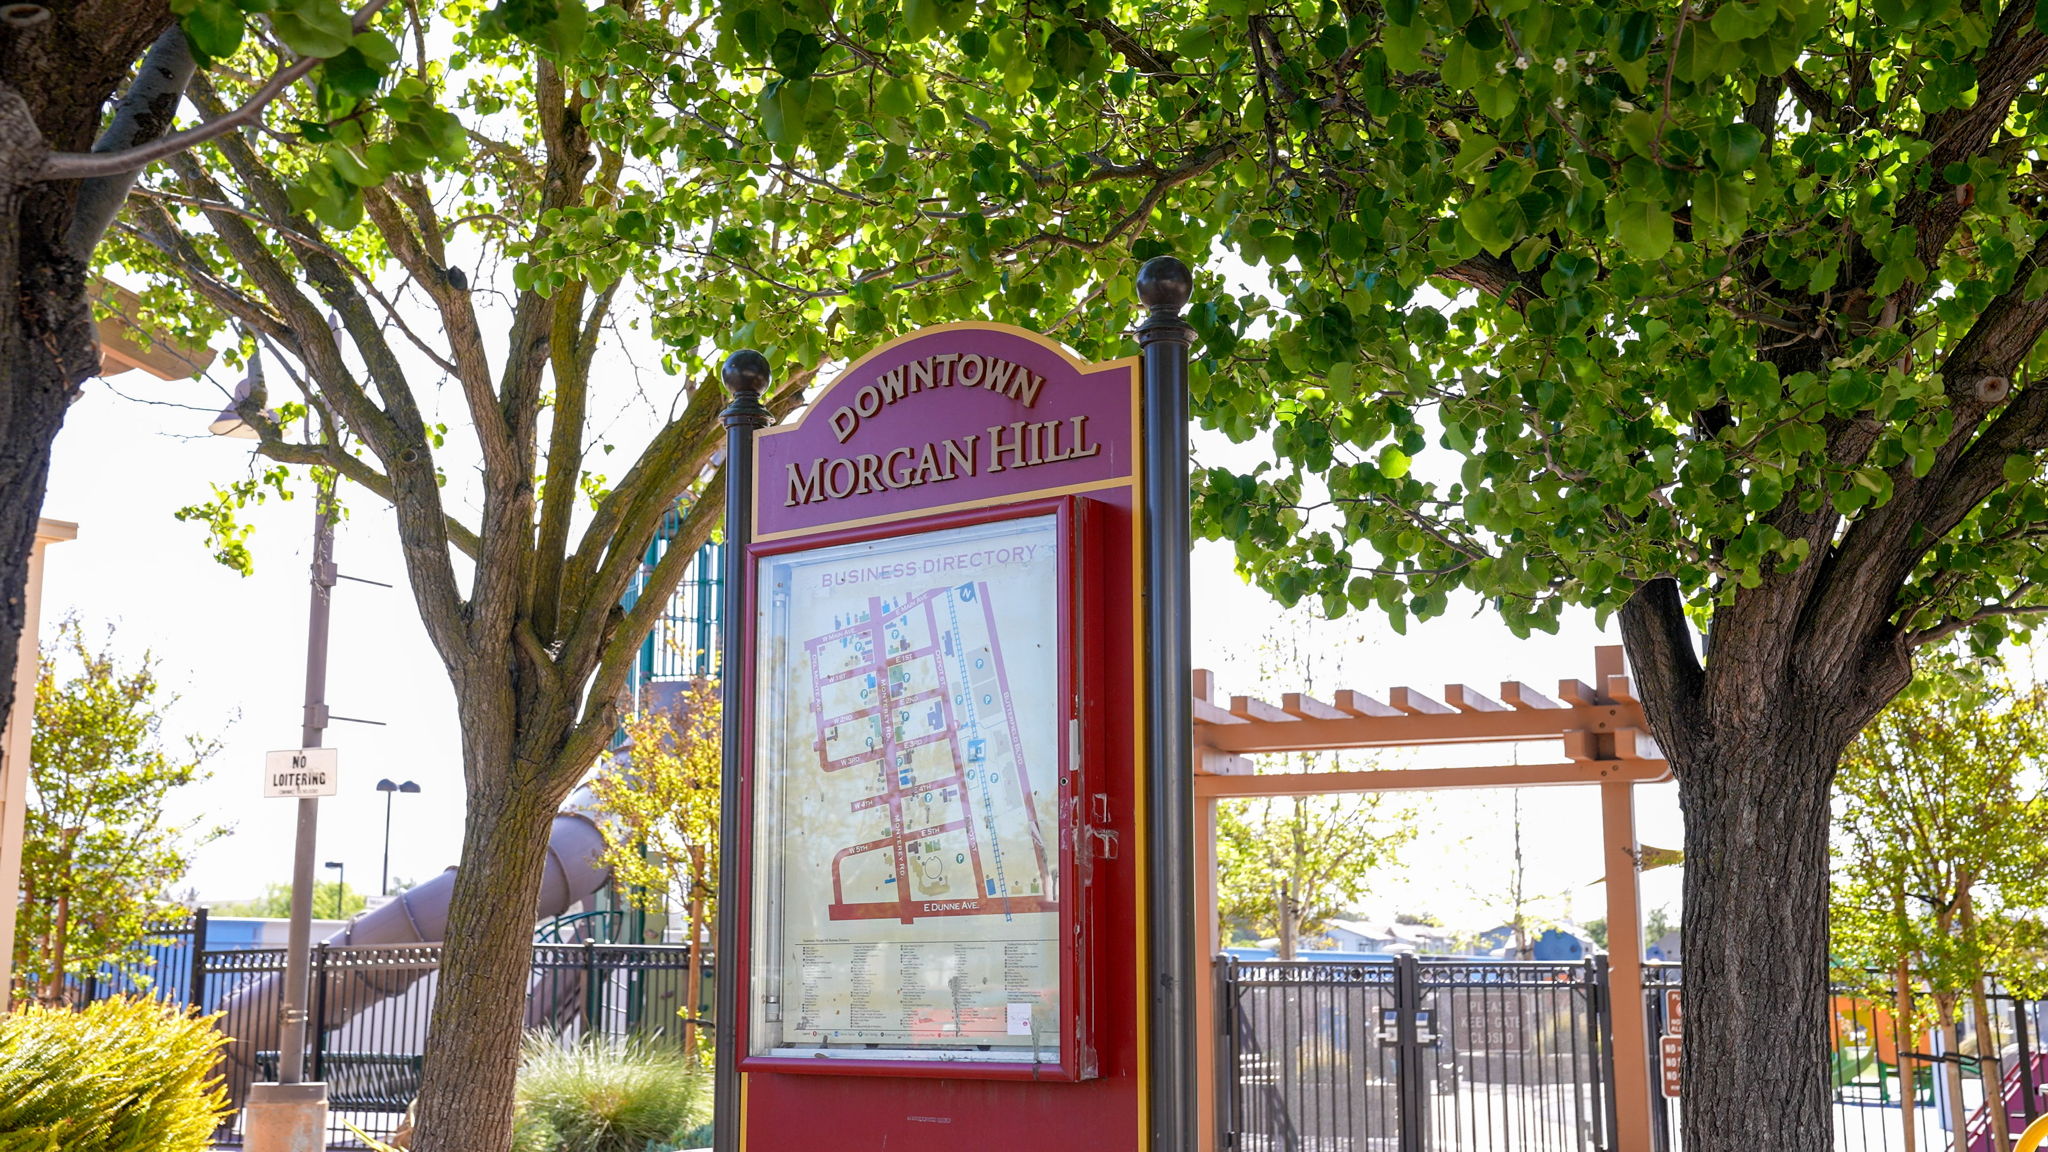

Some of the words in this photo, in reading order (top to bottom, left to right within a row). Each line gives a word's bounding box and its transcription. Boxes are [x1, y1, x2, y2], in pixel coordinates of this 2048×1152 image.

[828, 352, 1046, 444] DOWNTOWN
[784, 434, 980, 507] MORGAN
[986, 415, 1102, 473] HILL
[821, 561, 918, 588] BUSINESS
[923, 544, 1038, 574] DIRECTORY
[902, 654, 913, 662] 1ST
[880, 678, 890, 725] MONTEREY
[292, 755, 307, 769] NO
[273, 772, 326, 787] LOITERING
[856, 844, 868, 852] 5TH
[894, 815, 904, 862] MONTEREY
[931, 902, 960, 912] DUNNE
